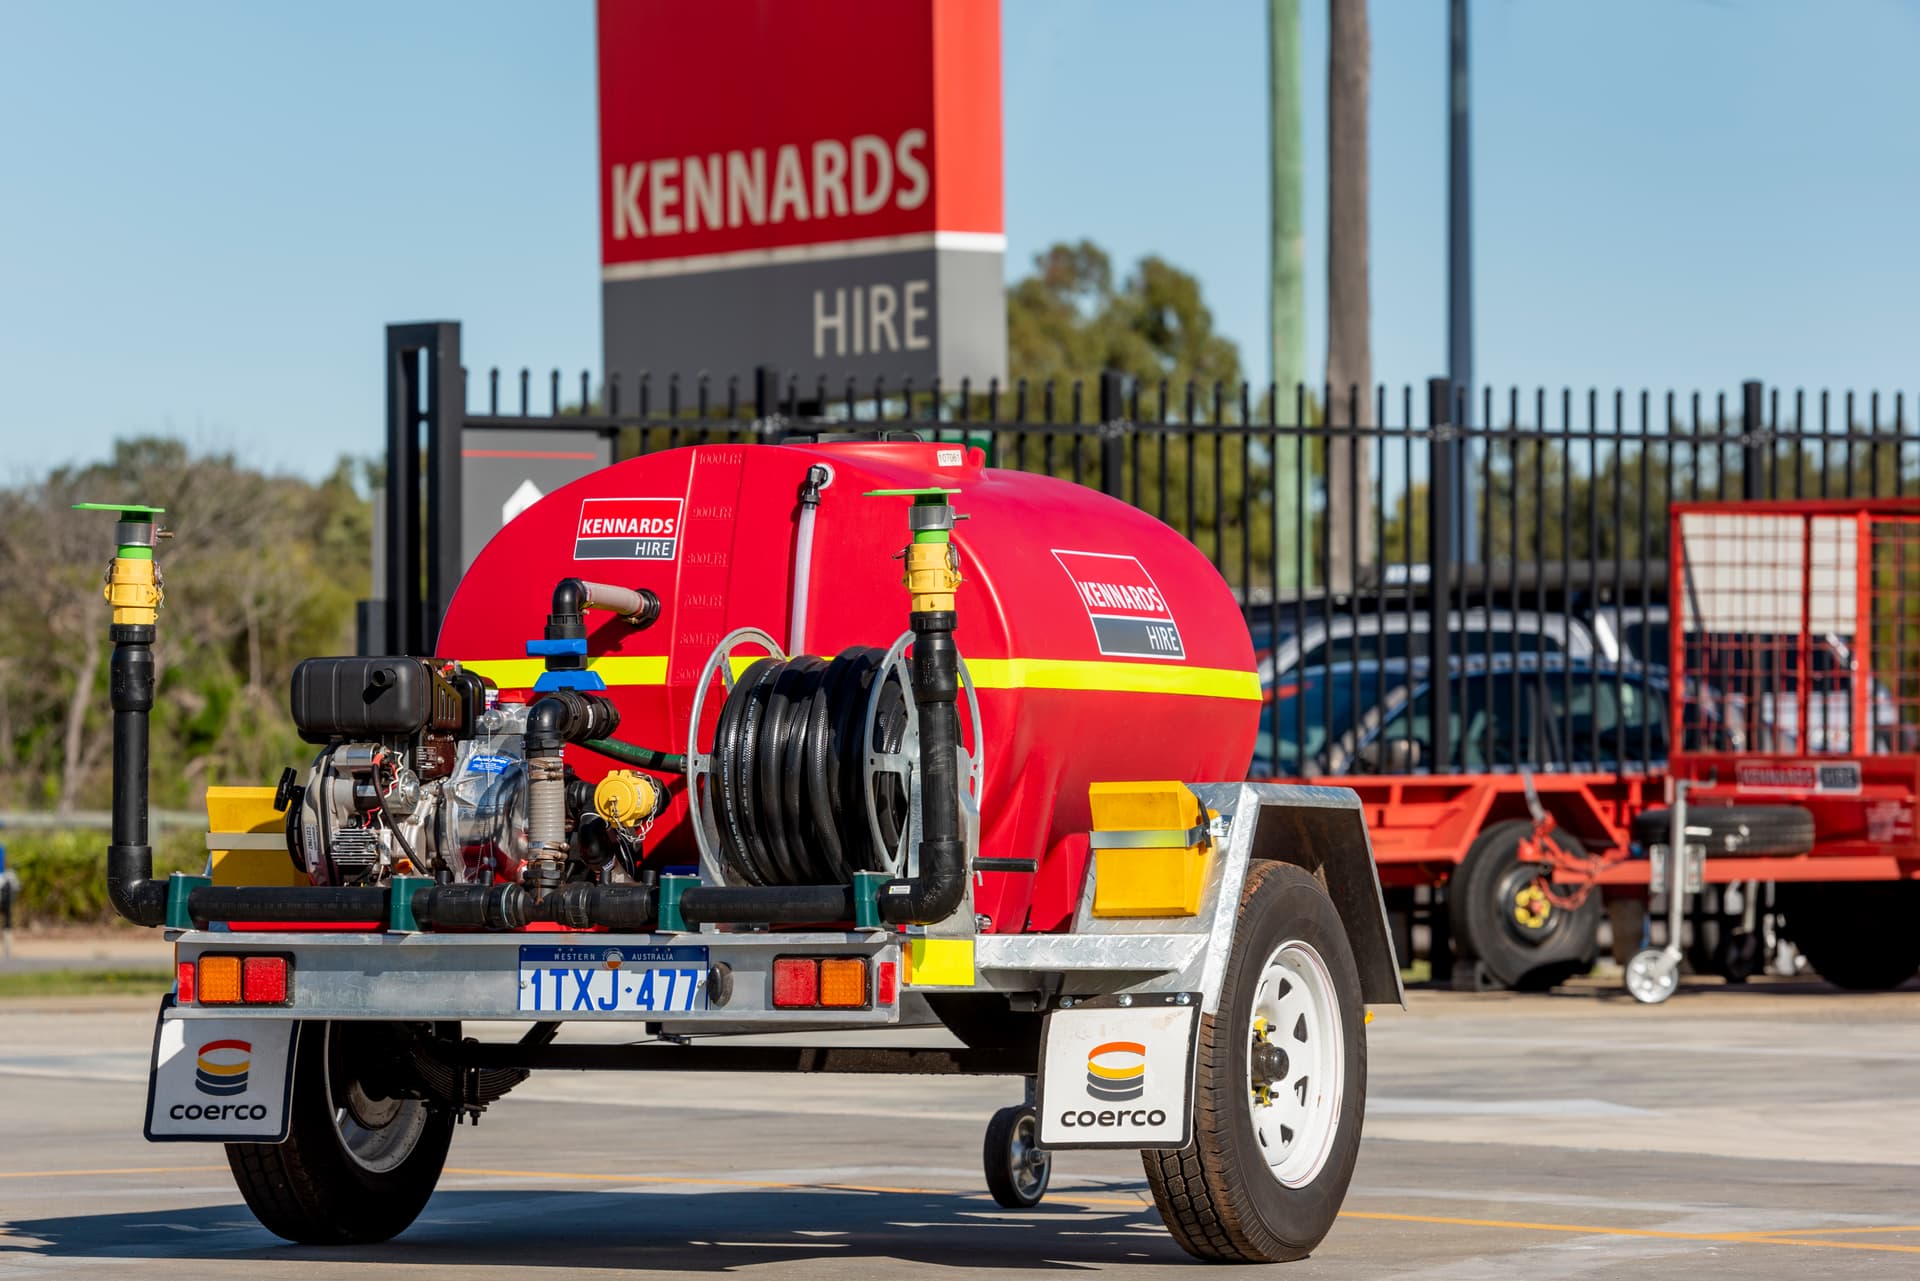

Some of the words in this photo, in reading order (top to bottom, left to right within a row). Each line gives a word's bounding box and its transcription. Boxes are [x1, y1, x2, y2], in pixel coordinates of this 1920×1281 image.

[612, 127, 930, 240] KENNARDS
[813, 280, 930, 358] HIRE
[581, 517, 675, 535] KENNARDS
[634, 542, 671, 557] HIRE
[1078, 581, 1165, 612] KENNARDS
[1145, 625, 1180, 651] HIRE
[554, 953, 596, 961] WESTERN
[631, 953, 674, 961] AUSTRALIA
[169, 1104, 267, 1120] coerco
[1060, 1109, 1167, 1127] coerco
